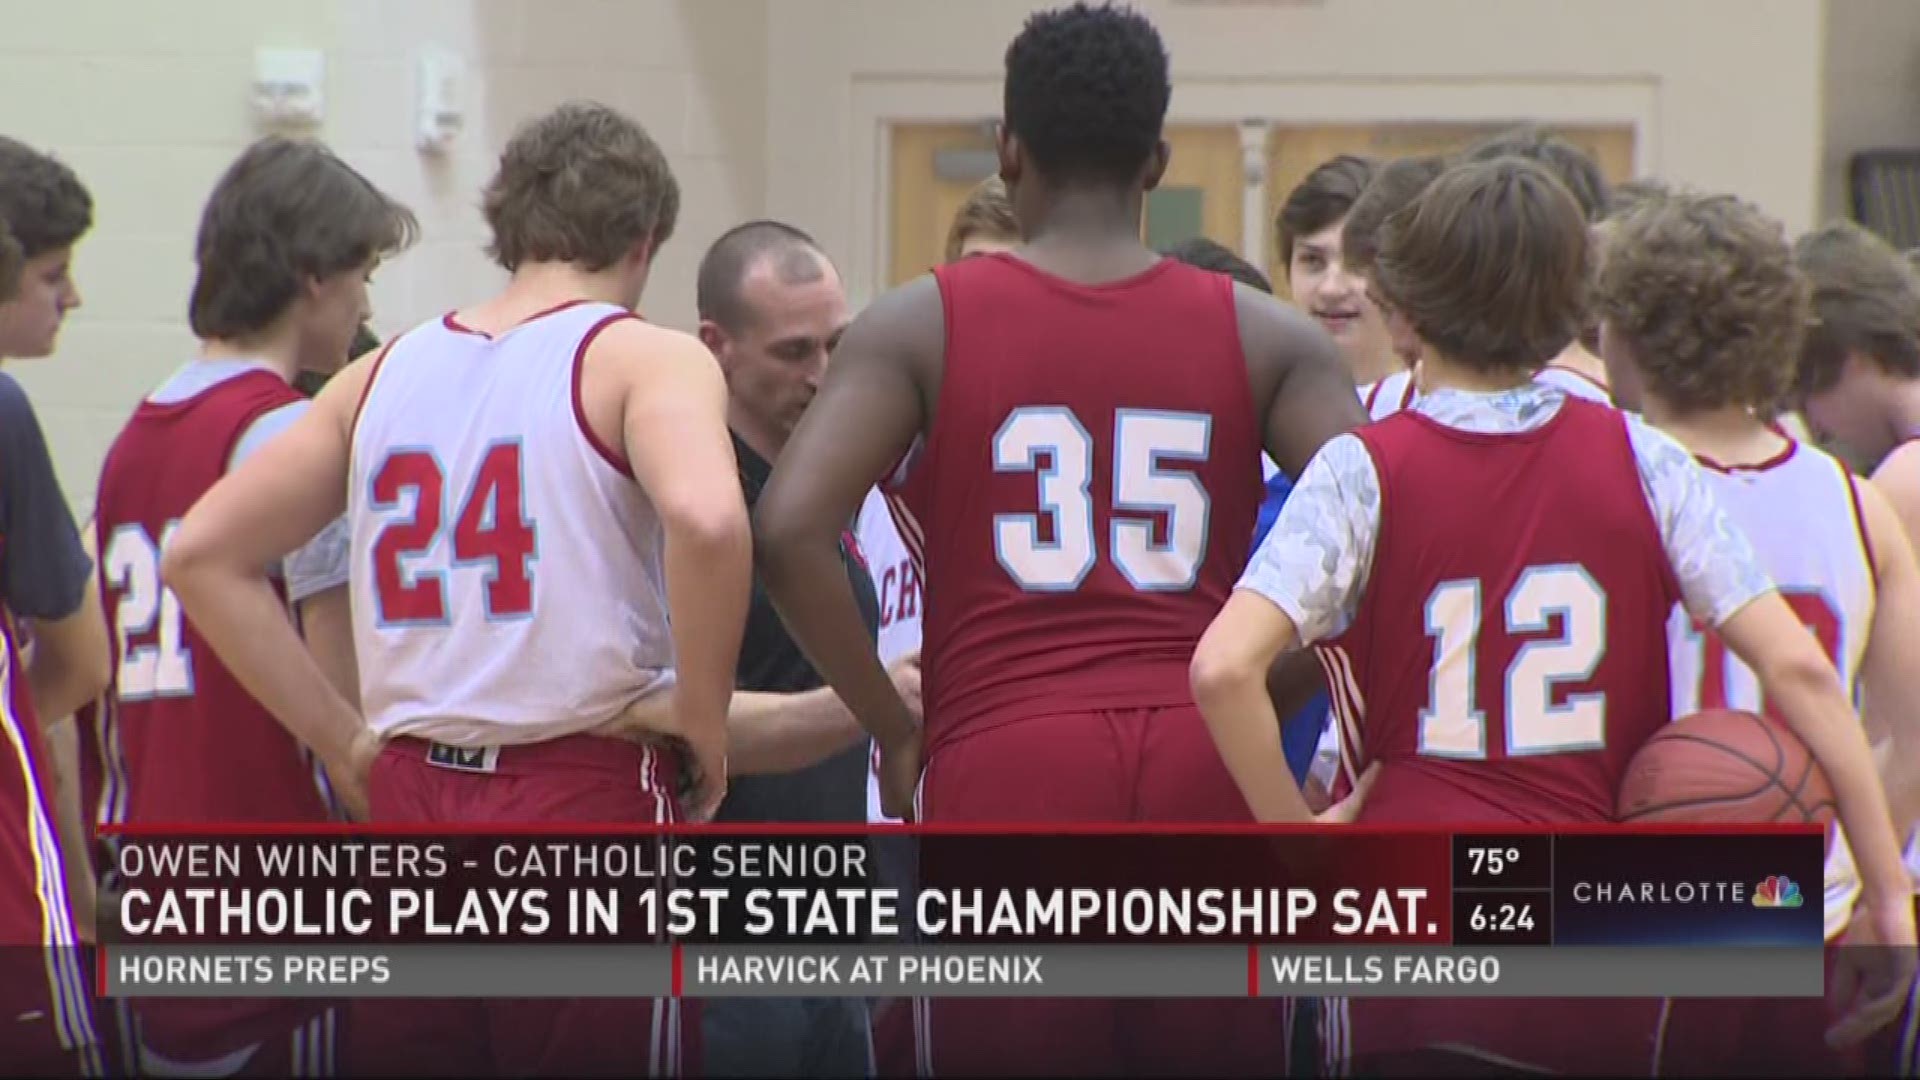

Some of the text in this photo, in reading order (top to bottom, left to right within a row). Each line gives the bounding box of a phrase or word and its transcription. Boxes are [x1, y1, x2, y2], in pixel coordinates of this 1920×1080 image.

[369, 435, 539, 630] 24
[991, 405, 1213, 592] 35
[1416, 562, 1608, 761] 12
